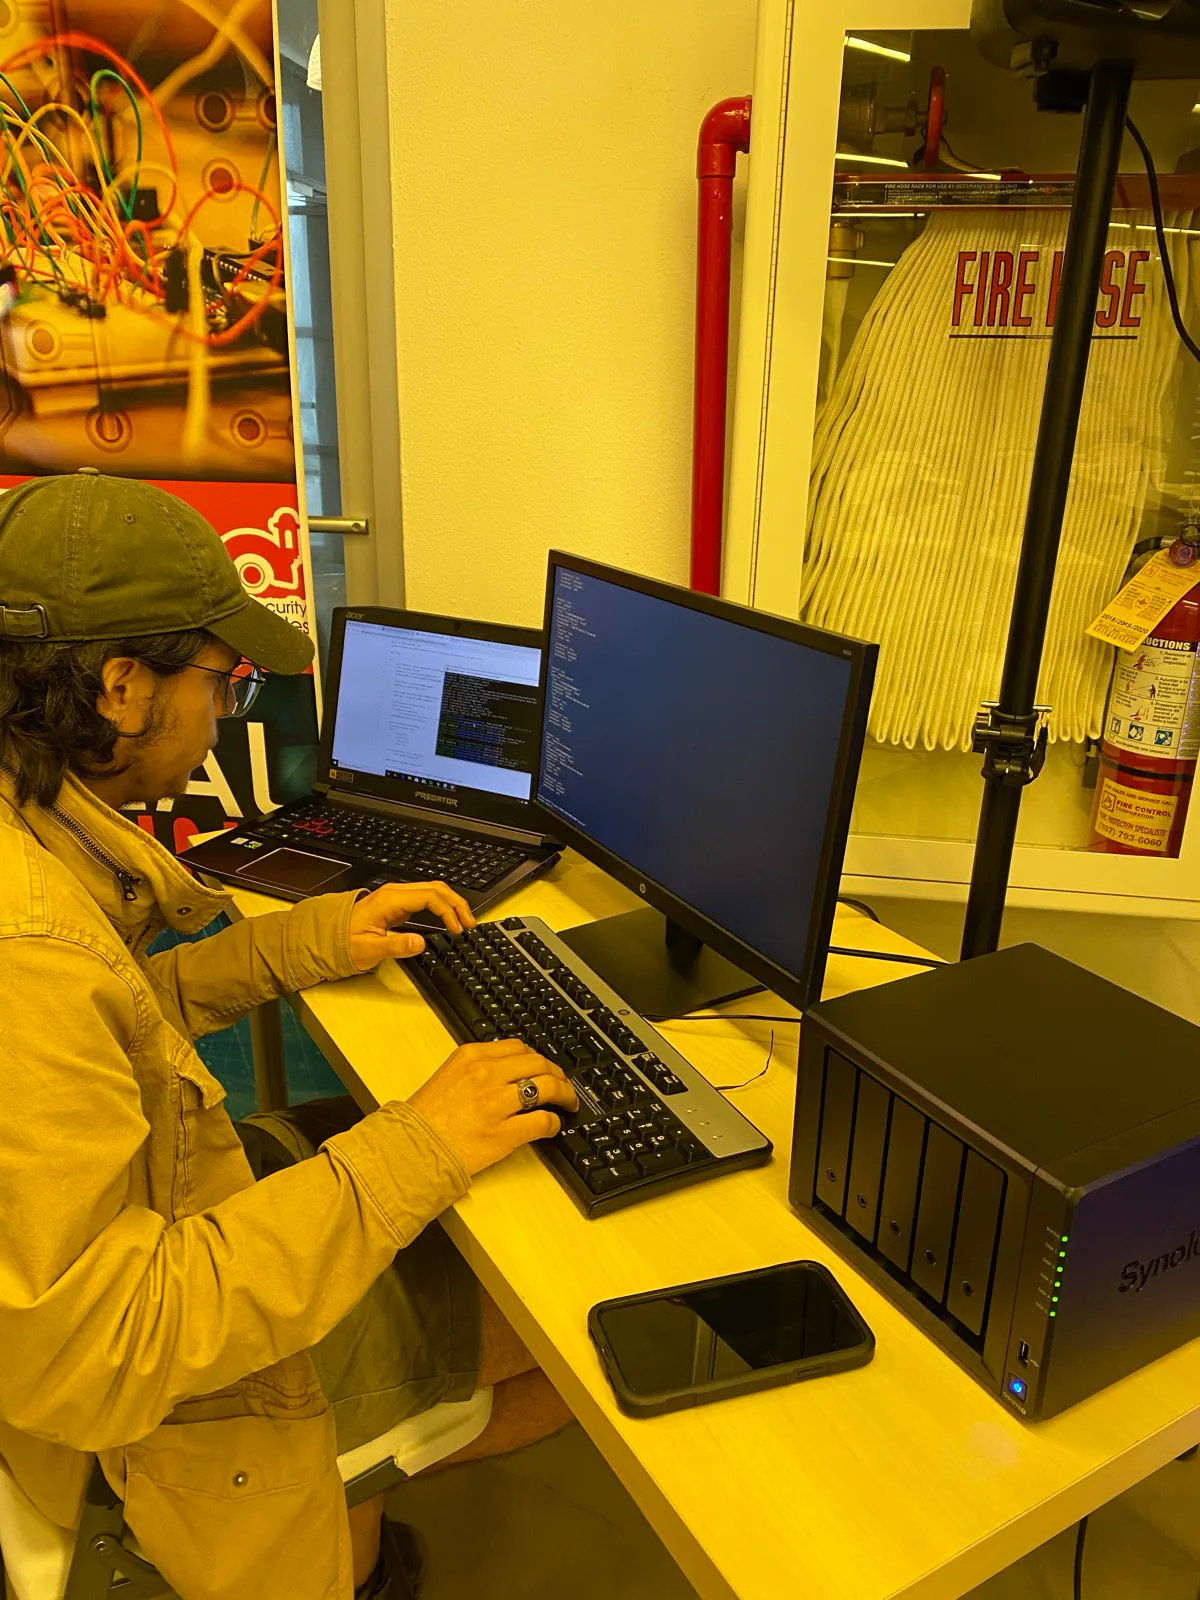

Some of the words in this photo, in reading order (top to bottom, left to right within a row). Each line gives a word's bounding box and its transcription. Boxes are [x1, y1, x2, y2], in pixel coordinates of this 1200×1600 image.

[951, 251, 1040, 328] FIRE
[1045, 250, 1150, 329] SE
[265, 601, 307, 618] curity
[345, 611, 365, 620] acer
[1143, 637, 1190, 651] UCTIONS
[415, 791, 458, 807] PREDATOR
[1112, 787, 1125, 795] SALES
[1138, 796, 1160, 804] SERVICE
[1116, 800, 1133, 810] FIRE
[1135, 805, 1172, 817] CONTROL
[1116, 806, 1154, 819] CORPORATION
[1107, 816, 1134, 830] PROTECTION
[1118, 831, 1162, 846] 793-6060
